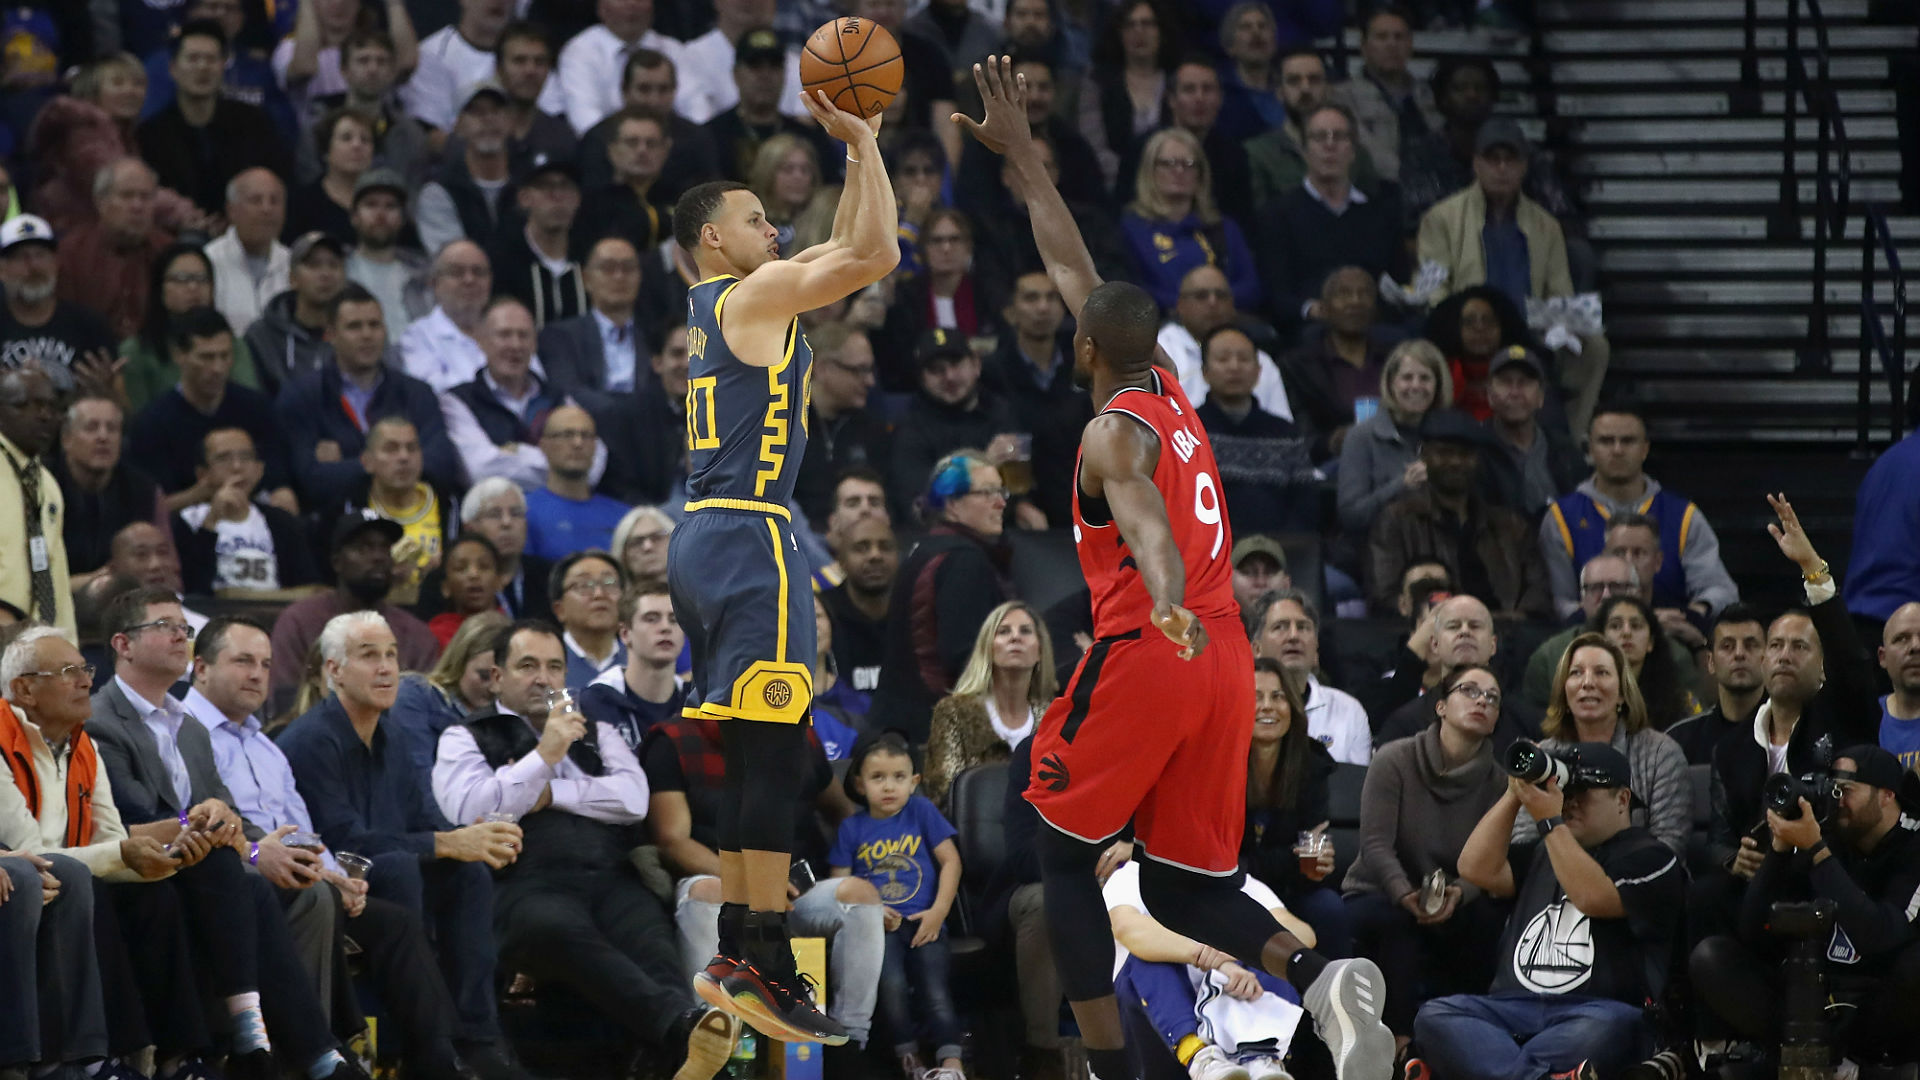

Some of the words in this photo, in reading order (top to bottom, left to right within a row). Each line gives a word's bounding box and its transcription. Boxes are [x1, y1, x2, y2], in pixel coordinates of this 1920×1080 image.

[1195, 471, 1224, 561] 9
[857, 833, 922, 871] TOWN
[1831, 944, 1850, 959] NBA
